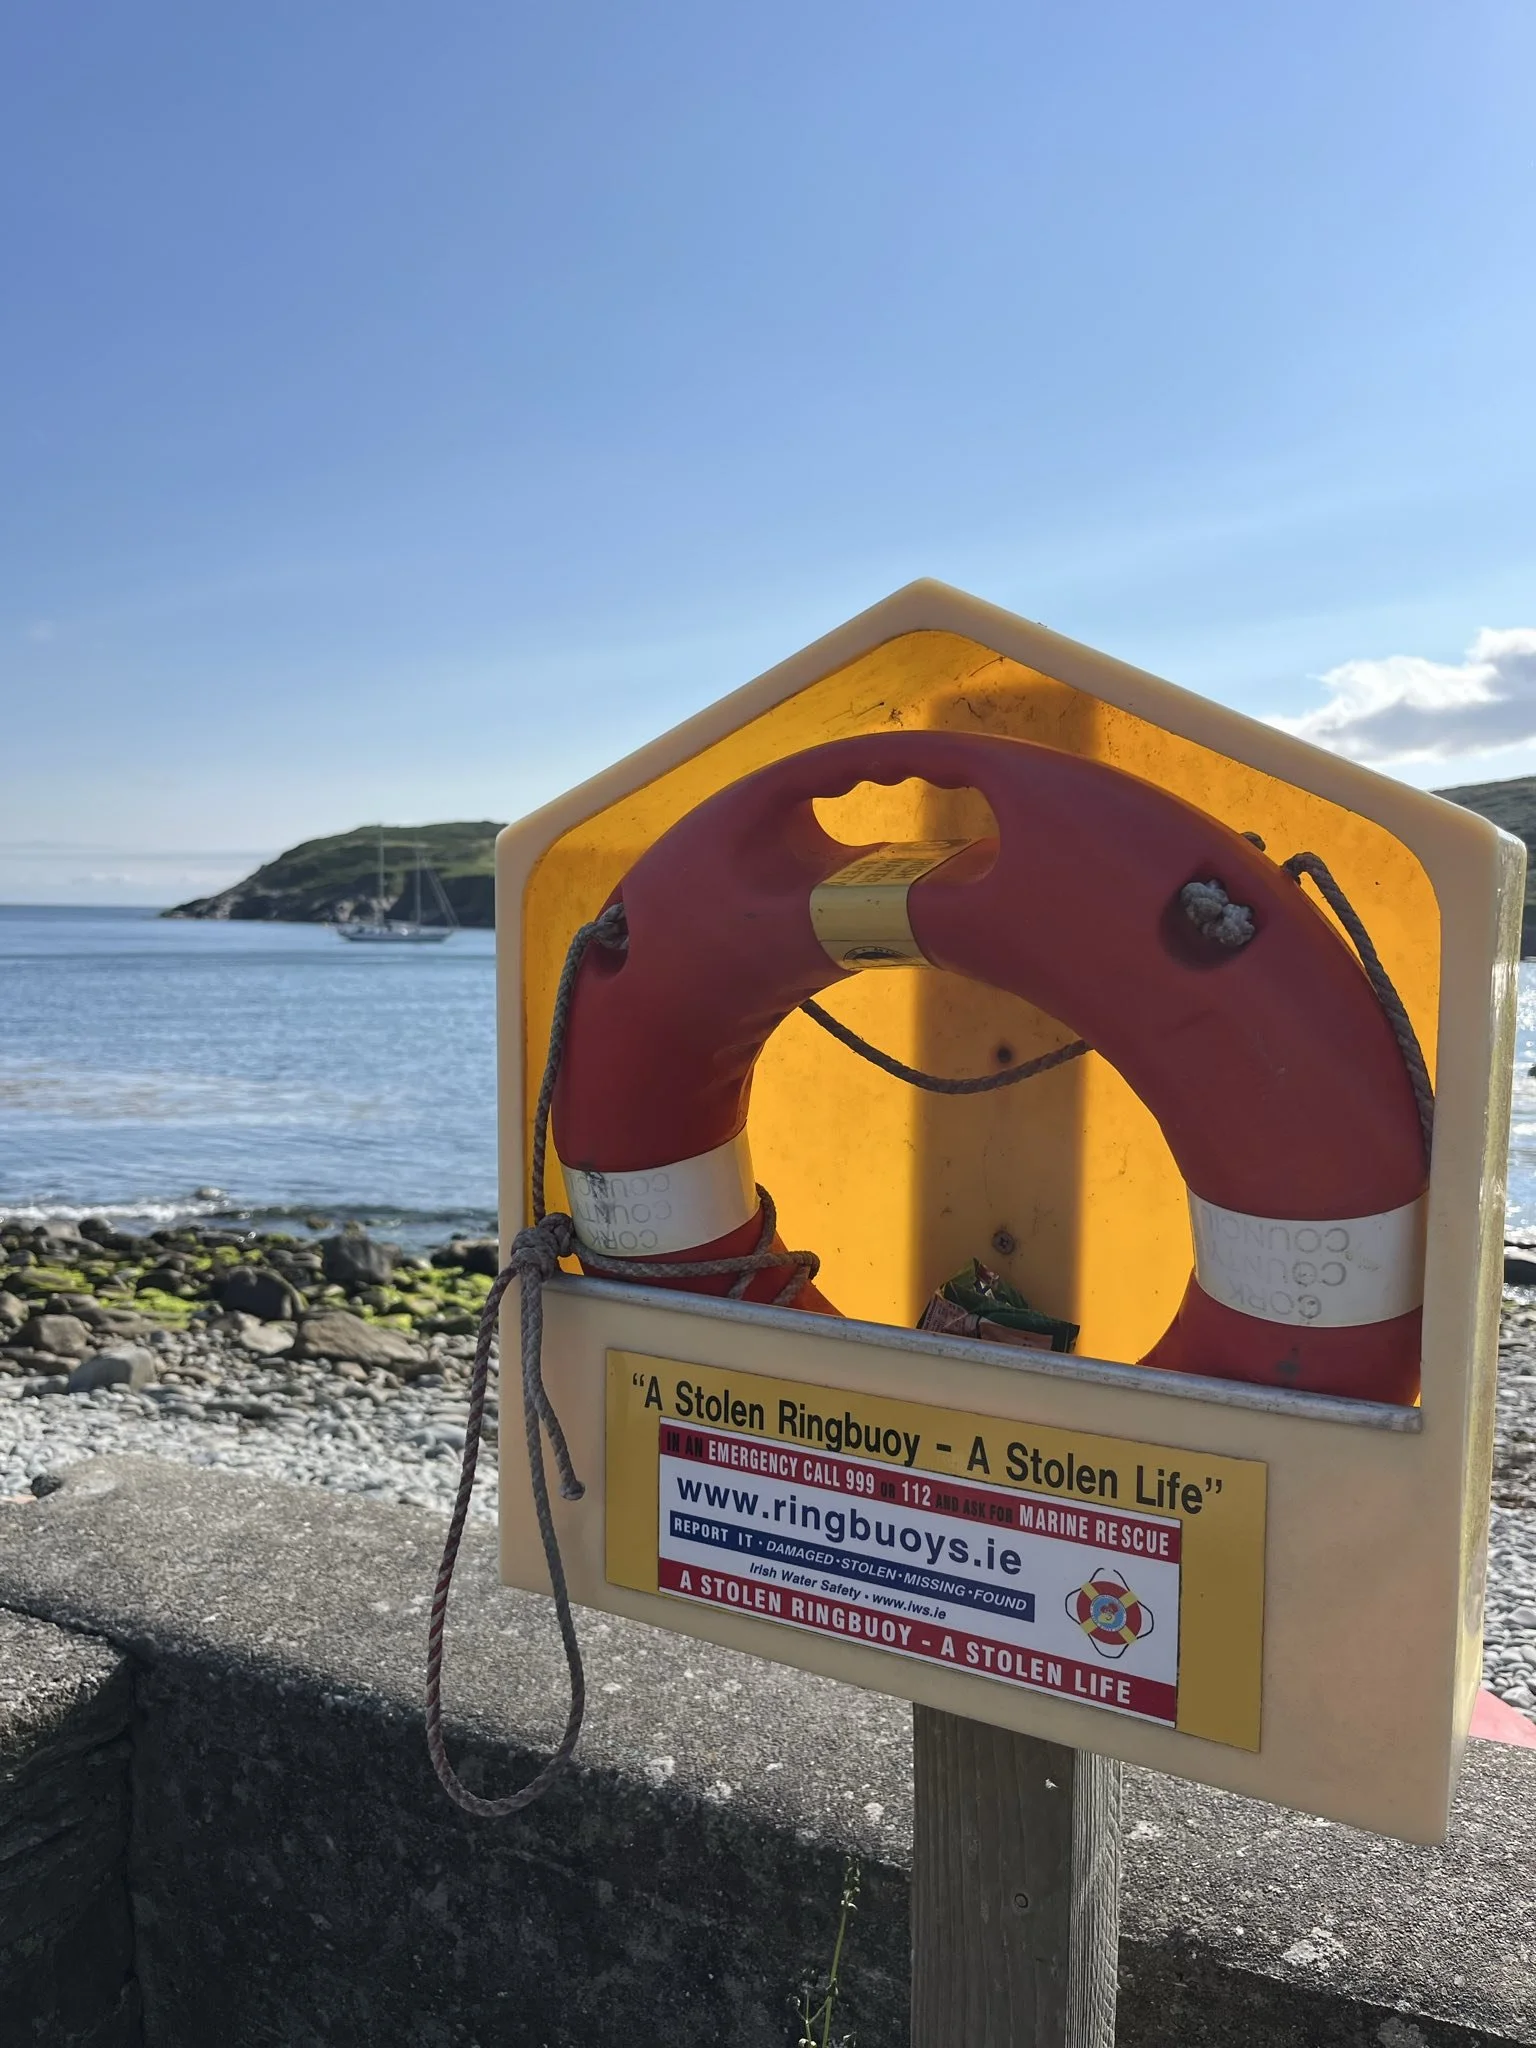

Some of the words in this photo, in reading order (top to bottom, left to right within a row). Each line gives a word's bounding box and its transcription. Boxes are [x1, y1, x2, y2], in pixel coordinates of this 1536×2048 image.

[587, 1228, 659, 1251] CORK
[1200, 1205, 1350, 1254] COUNCIL
[1210, 1240, 1348, 1288] COUNTY
[1228, 1279, 1323, 1320] CORK
[675, 1380, 765, 1431] Stolen
[778, 1399, 921, 1467] Ringbuoy
[966, 1436, 991, 1475] A
[1006, 1442, 1118, 1499] Stolen
[666, 1431, 680, 1452] IN
[685, 1436, 703, 1458] AN
[708, 1440, 798, 1478] EMERGENCY
[803, 1462, 841, 1488] CALL
[846, 1471, 875, 1495] 999
[881, 1481, 896, 1499] OR
[901, 1481, 931, 1507] 112
[935, 1493, 959, 1512] AND
[963, 1498, 986, 1518] ASK
[989, 1505, 1014, 1524] FOR
[1019, 1504, 1088, 1540] MARINE
[1095, 1520, 1169, 1556] RESCUE
[674, 1517, 729, 1543] REPORT
[738, 1532, 753, 1548] IT
[676, 1476, 1023, 1576] www.ringbuoys.ie
[750, 1562, 777, 1580] Irish
[780, 1570, 818, 1588] Water
[820, 1579, 861, 1601] Safety
[872, 1592, 947, 1621] www.iws.ie
[680, 1570, 693, 1592] A
[700, 1575, 782, 1614] STOLEN
[791, 1597, 912, 1646] RINGBUOY
[940, 1635, 955, 1658] A
[966, 1641, 1063, 1687] STOLEN
[1074, 1669, 1131, 1705] LIFE
